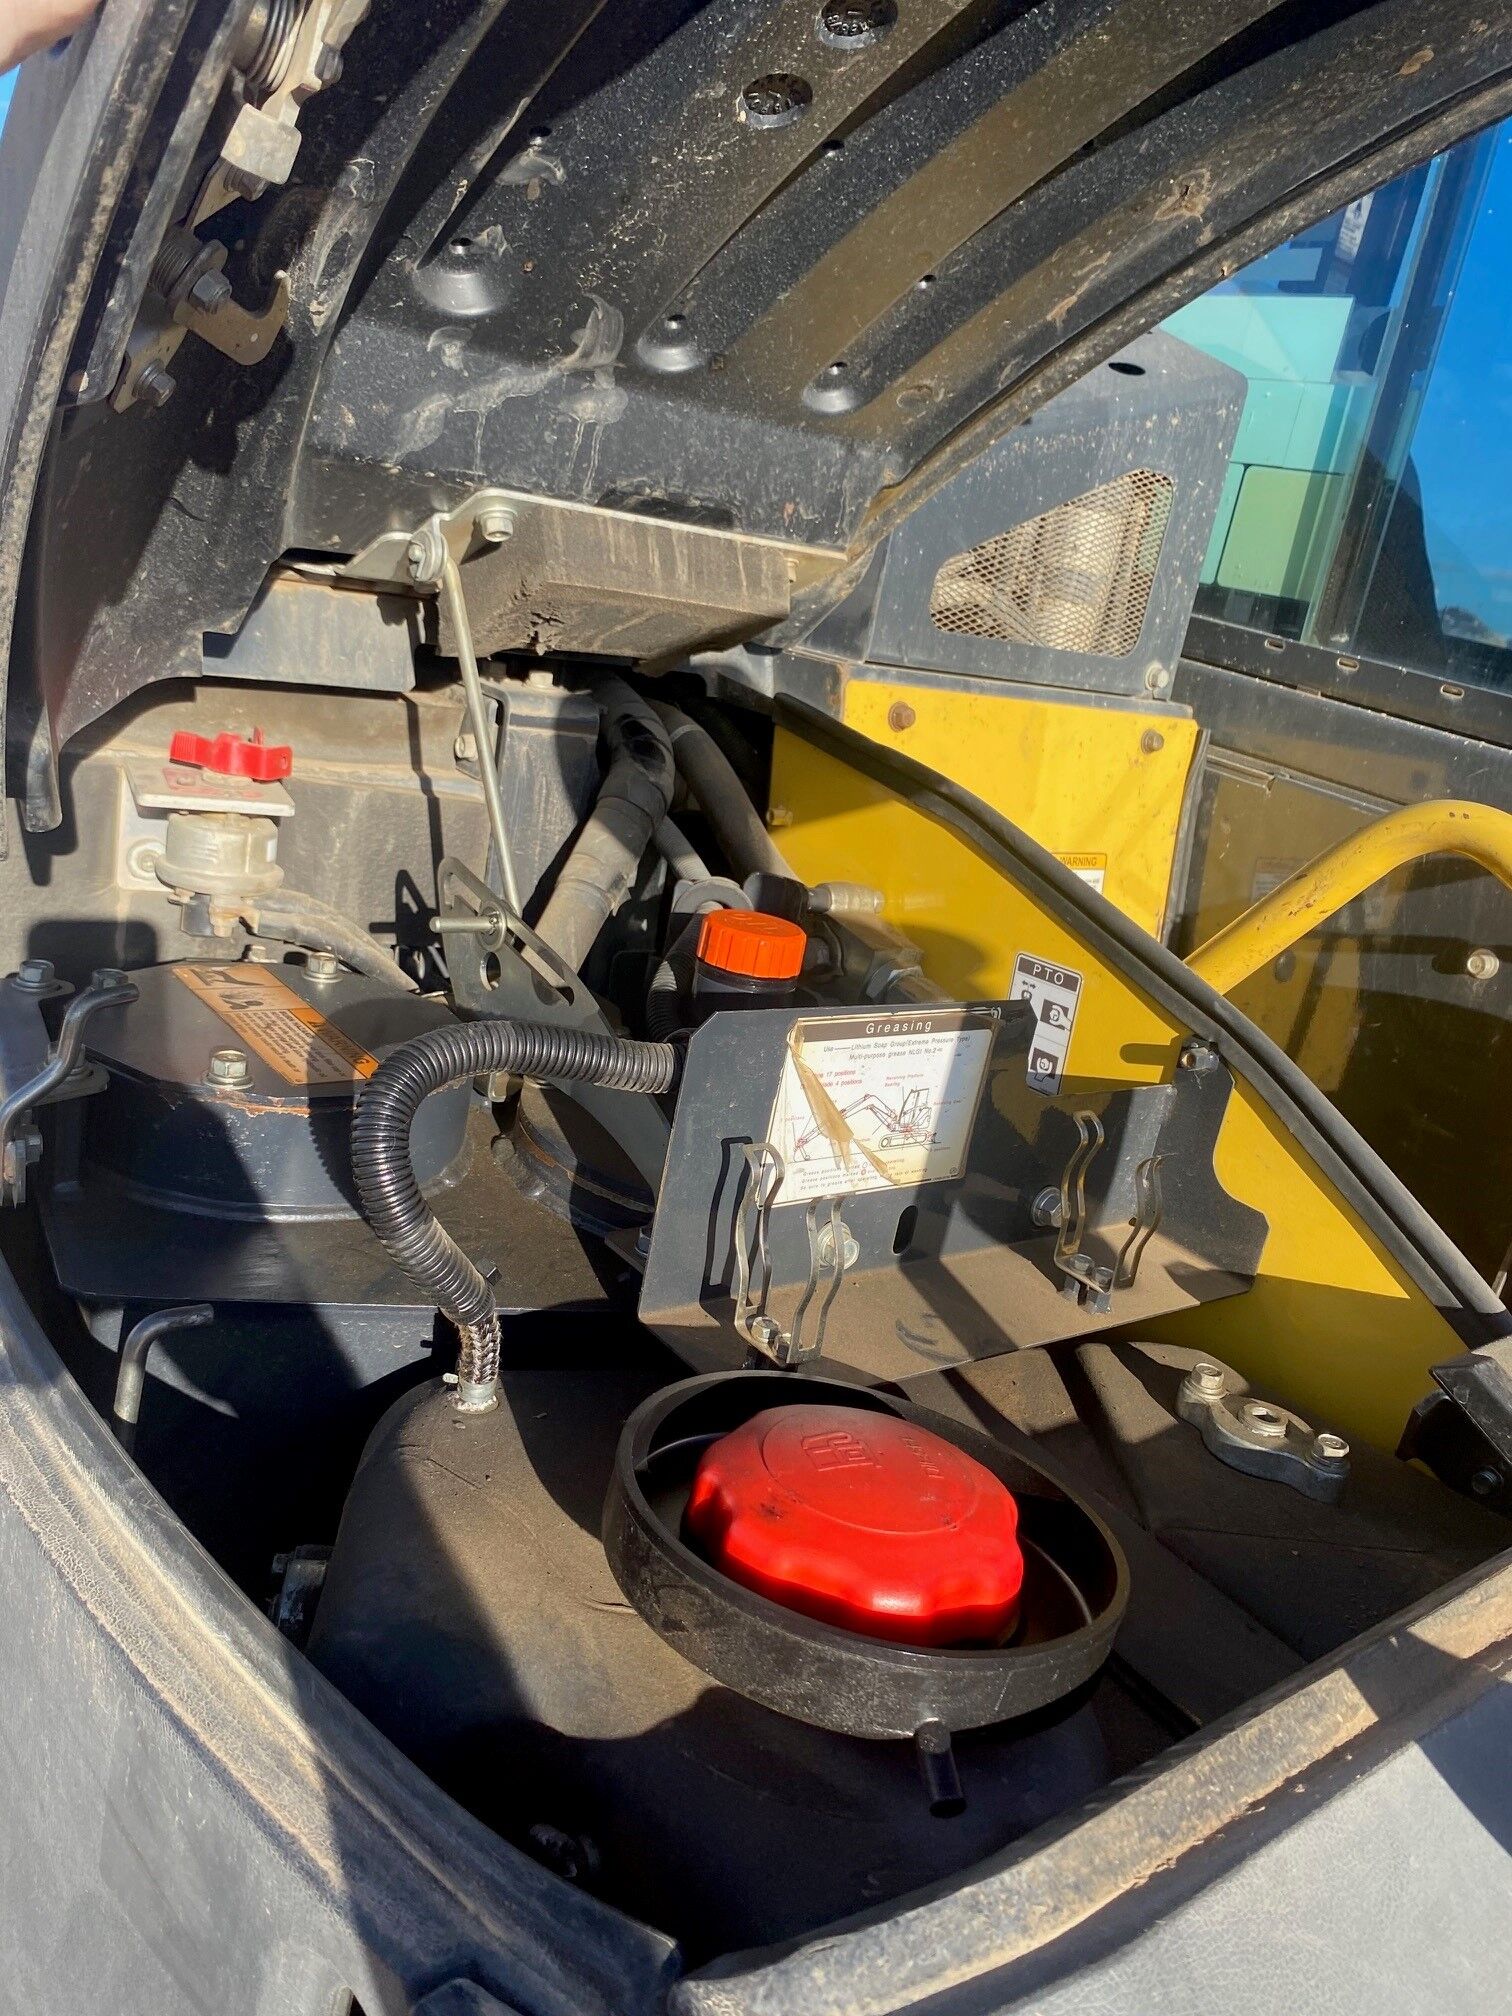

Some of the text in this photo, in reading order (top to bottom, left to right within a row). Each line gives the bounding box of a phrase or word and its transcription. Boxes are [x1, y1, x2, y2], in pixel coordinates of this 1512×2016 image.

[1032, 963, 1064, 985] PTO
[865, 1020, 933, 1035] Greasing
[931, 1035, 955, 1045] Pressure
[887, 1050, 907, 1060] grease
